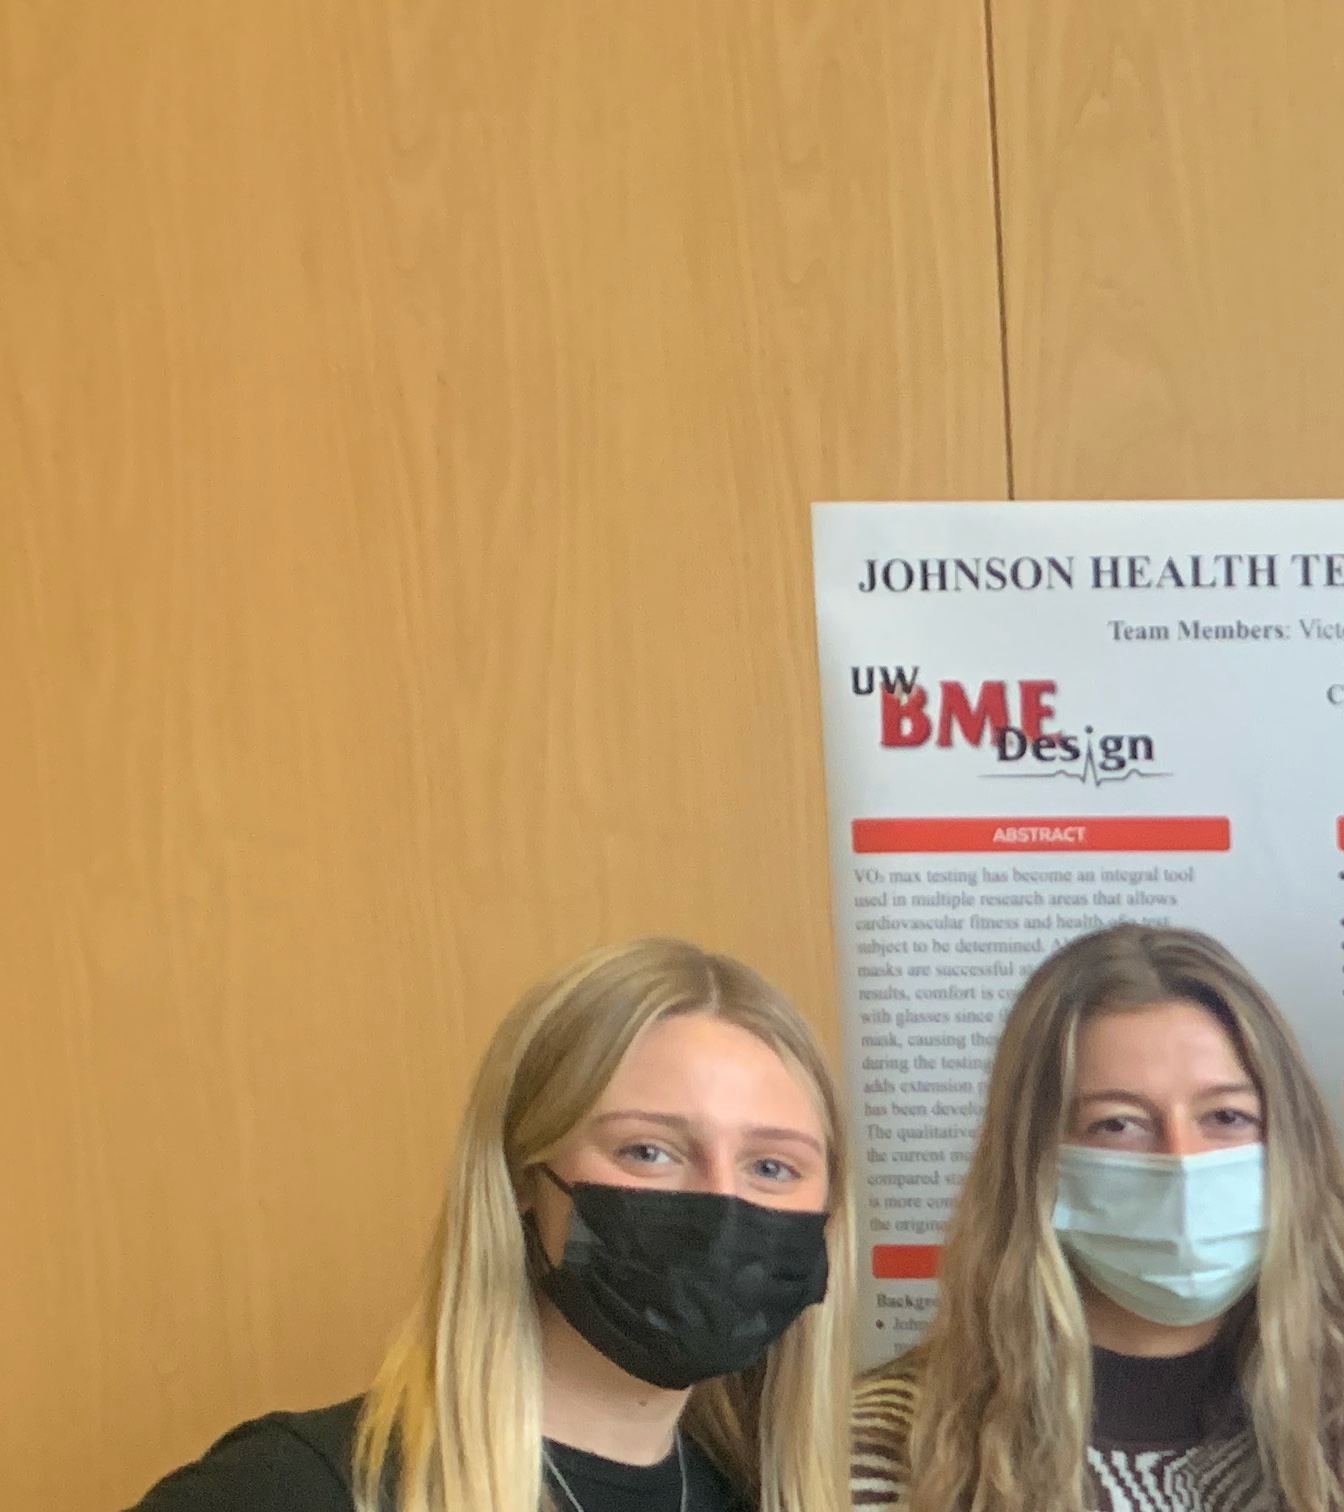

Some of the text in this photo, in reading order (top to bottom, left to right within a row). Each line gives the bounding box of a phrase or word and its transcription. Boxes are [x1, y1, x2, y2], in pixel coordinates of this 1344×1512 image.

[858, 555, 1076, 593] JOHNSON
[1091, 553, 1280, 590] HEALTH
[1107, 619, 1170, 642] Team
[1177, 619, 1289, 642] Members:
[851, 666, 920, 696] UW
[880, 680, 1064, 749] BME
[996, 724, 1155, 774] Design
[993, 826, 1087, 843] ABSTRACT
[889, 865, 1195, 887] max testing has become an integral tool
[911, 891, 976, 911] multiple
[979, 890, 1045, 907] research
[1023, 914, 1052, 930] and
[914, 985, 977, 1001] comfort
[859, 1008, 891, 1024] with
[896, 1008, 950, 1029] glasses
